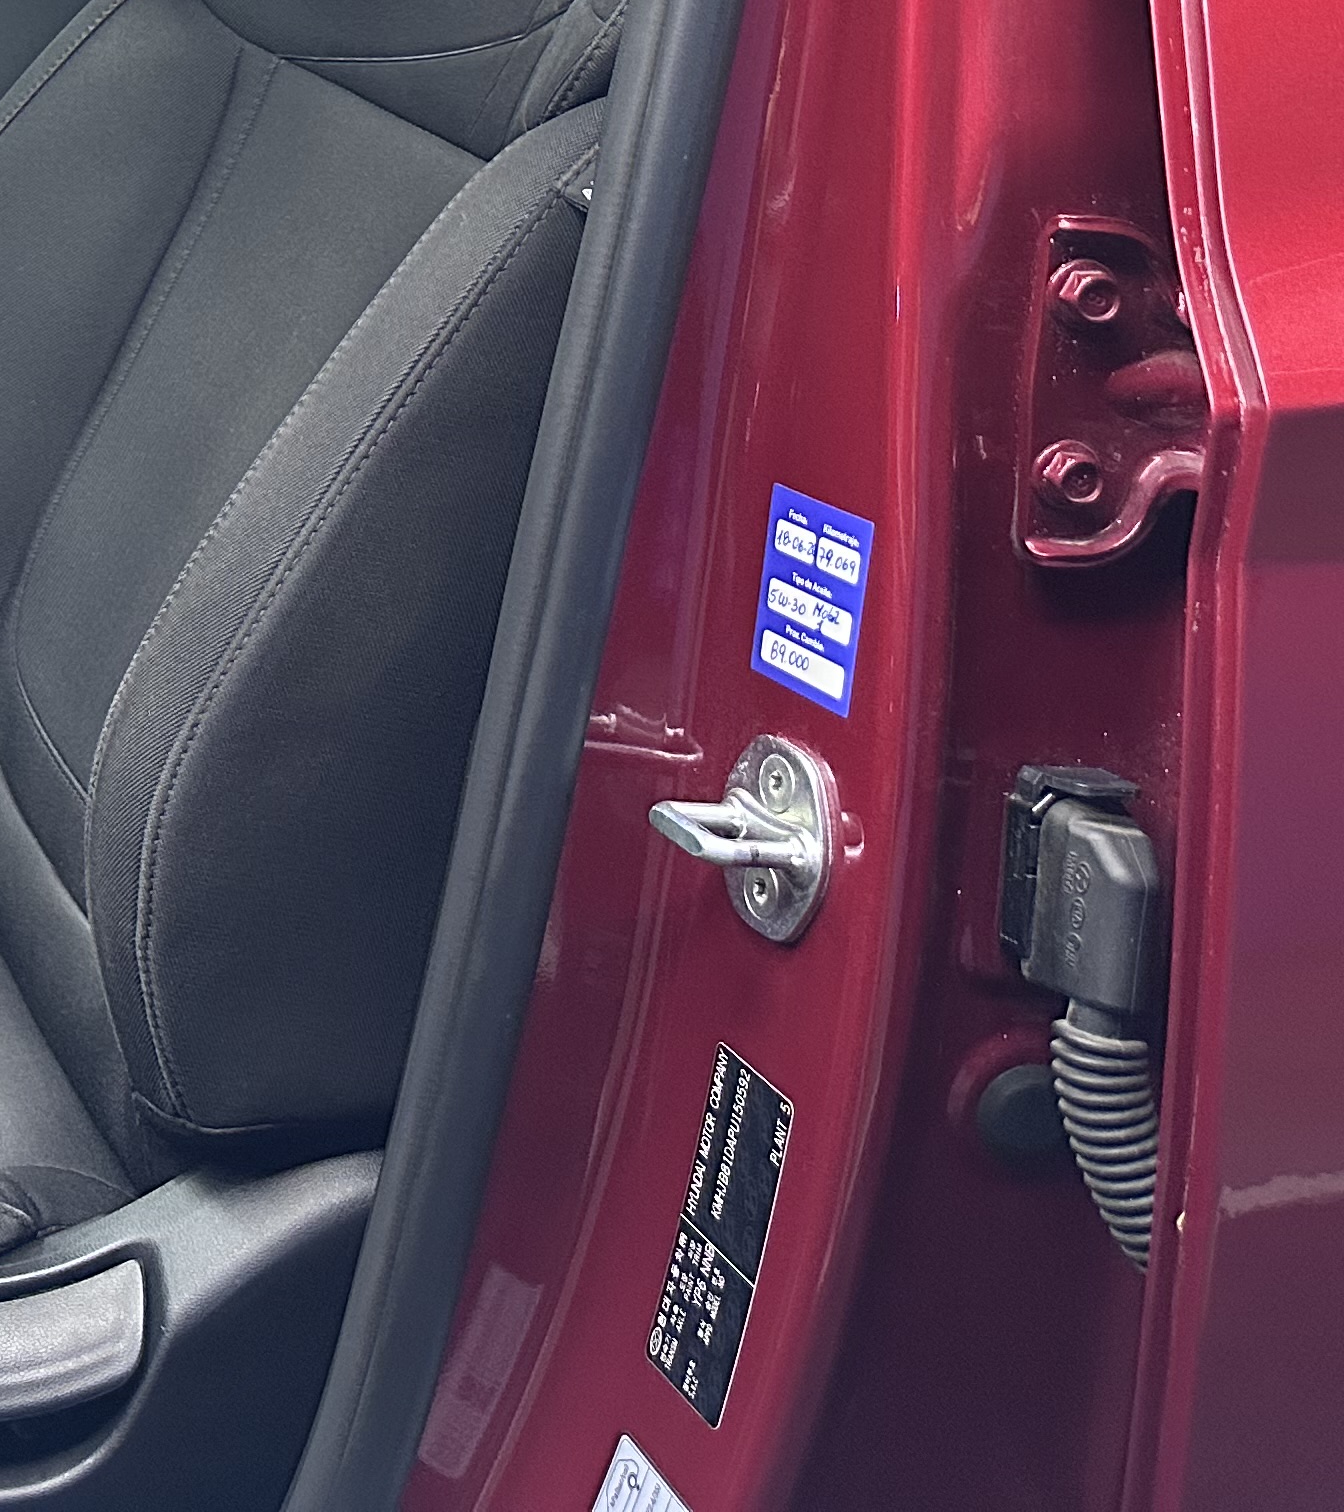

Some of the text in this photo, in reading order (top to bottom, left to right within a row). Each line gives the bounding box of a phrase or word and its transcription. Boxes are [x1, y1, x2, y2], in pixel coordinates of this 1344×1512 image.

[685, 1048, 729, 1216] HYUNDAI MOTOR COMPANY
[769, 1101, 791, 1167] PLANT 5
[691, 1242, 703, 1267] TRIM
[691, 1277, 707, 1307] YP6
